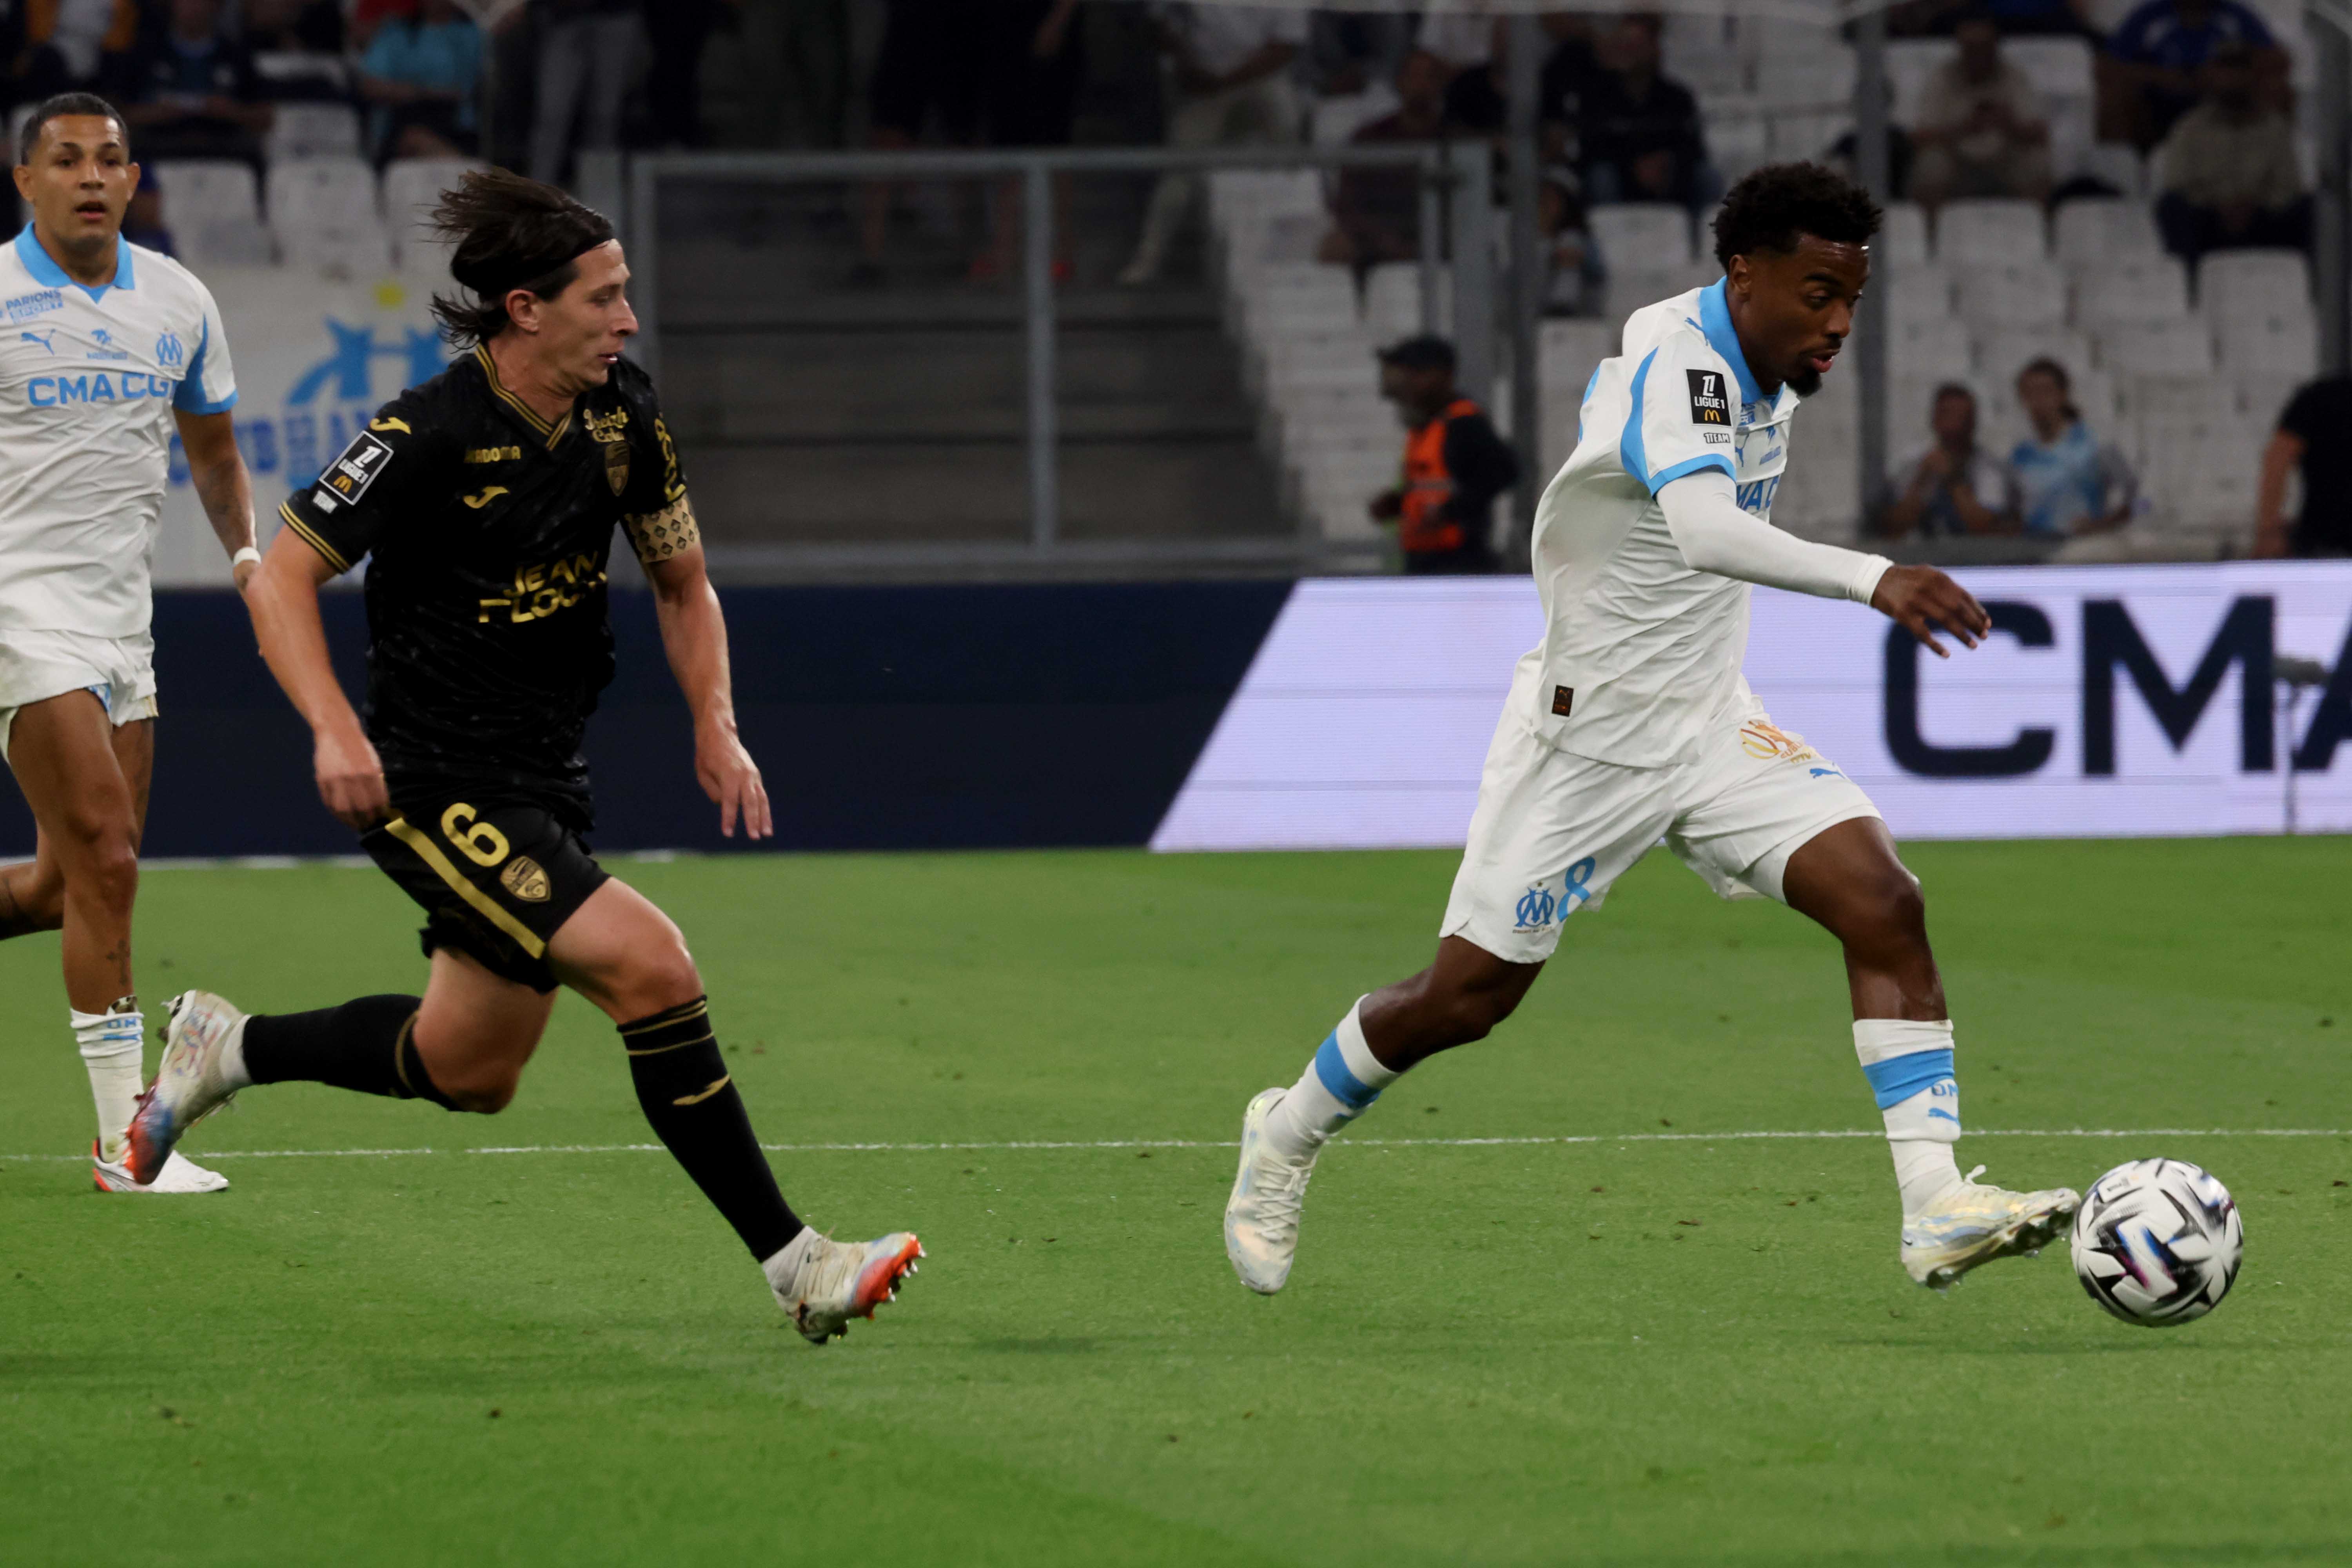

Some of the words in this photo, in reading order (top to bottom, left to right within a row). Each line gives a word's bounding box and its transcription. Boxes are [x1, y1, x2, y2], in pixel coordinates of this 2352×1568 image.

[5, 289, 62, 309] PARIONS
[28, 373, 115, 407] CMA
[122, 372, 176, 399] CG
[503, 551, 598, 597] JEAN
[441, 802, 510, 867] 6
[1557, 856, 1595, 922] 8
